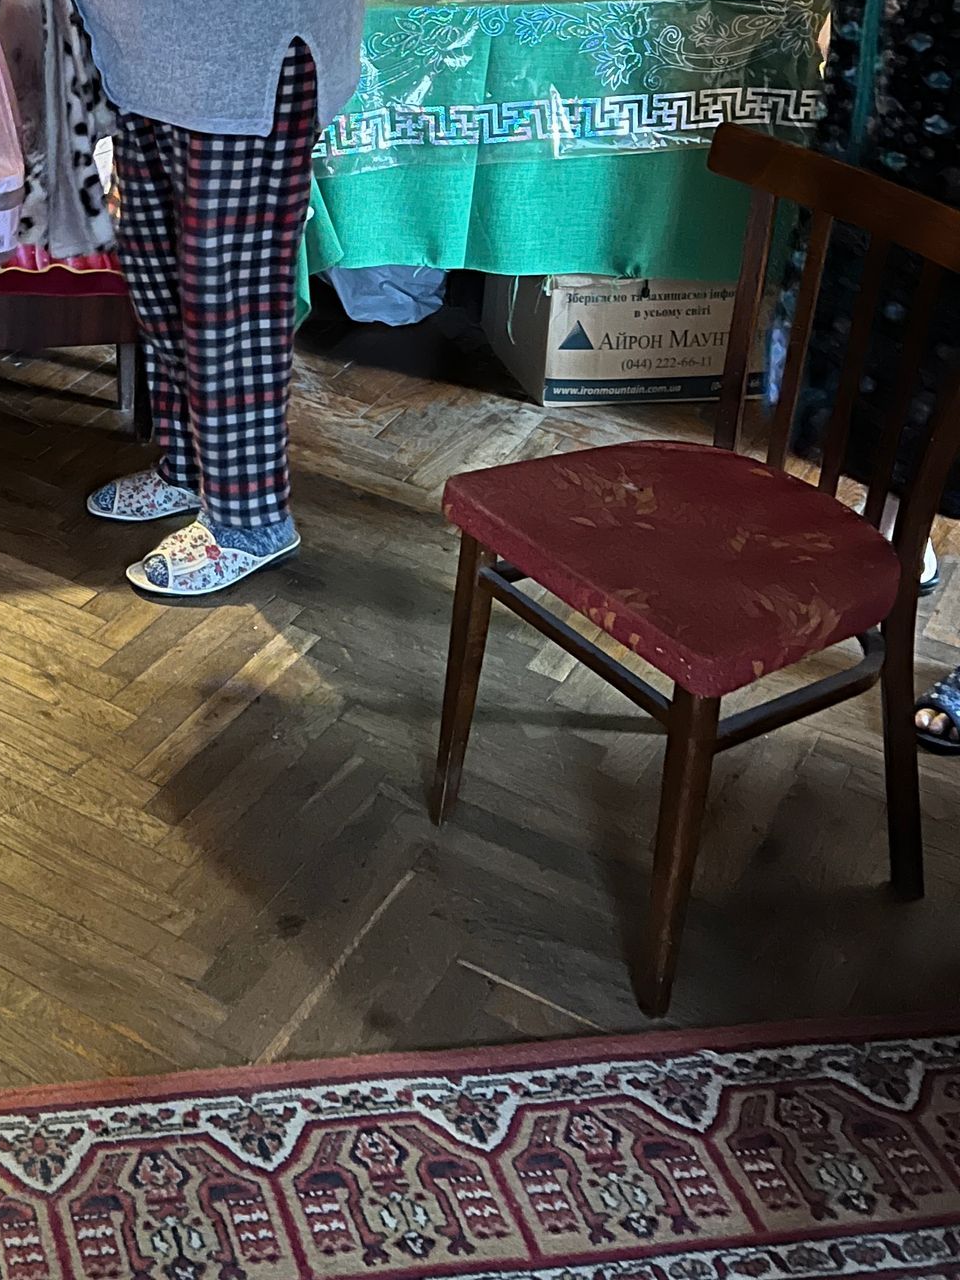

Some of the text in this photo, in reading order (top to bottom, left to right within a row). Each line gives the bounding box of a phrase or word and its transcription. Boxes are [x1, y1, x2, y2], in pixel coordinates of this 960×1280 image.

[709, 288, 736, 301] інфо
[634, 305, 711, 320] в усьому світі
[670, 330, 729, 349] МАУН
[621, 357, 712, 371] (044) 222-66-11
[553, 384, 682, 395] www.ironmountain.com.ua
